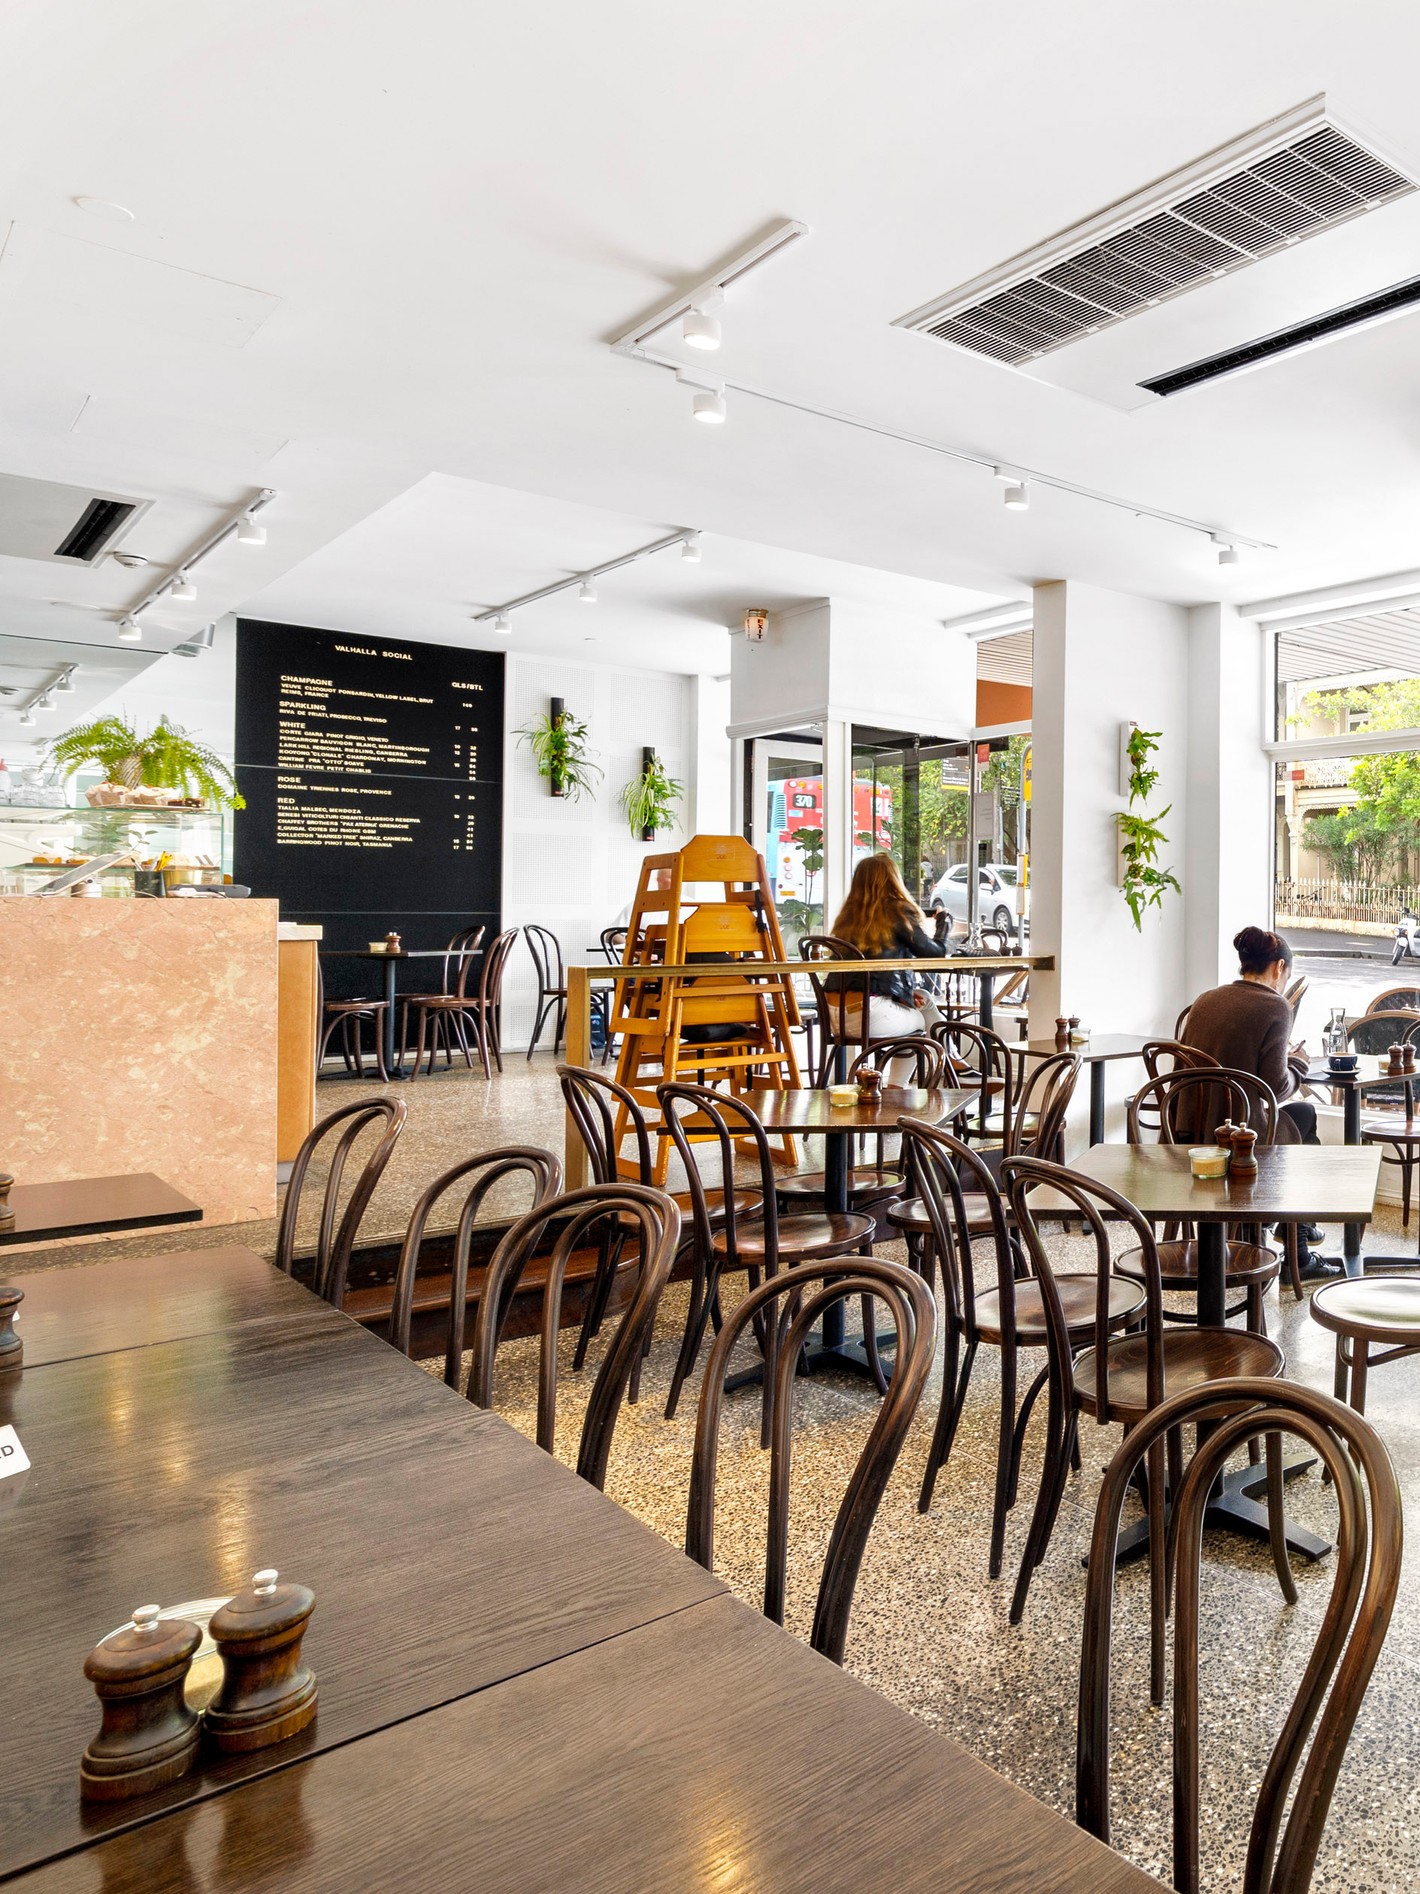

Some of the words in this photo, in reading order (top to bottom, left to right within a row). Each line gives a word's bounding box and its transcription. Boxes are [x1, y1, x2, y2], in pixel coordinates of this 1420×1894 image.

[335, 645, 377, 656] VALHALLA
[382, 651, 412, 660] SOCIAL
[280, 675, 333, 686] CHAMPAGNE
[452, 682, 483, 691] GLS/BTL
[279, 701, 326, 711] SPARKLING
[379, 744, 430, 752] MARTINBOROUGH
[795, 795, 813, 807] 370
